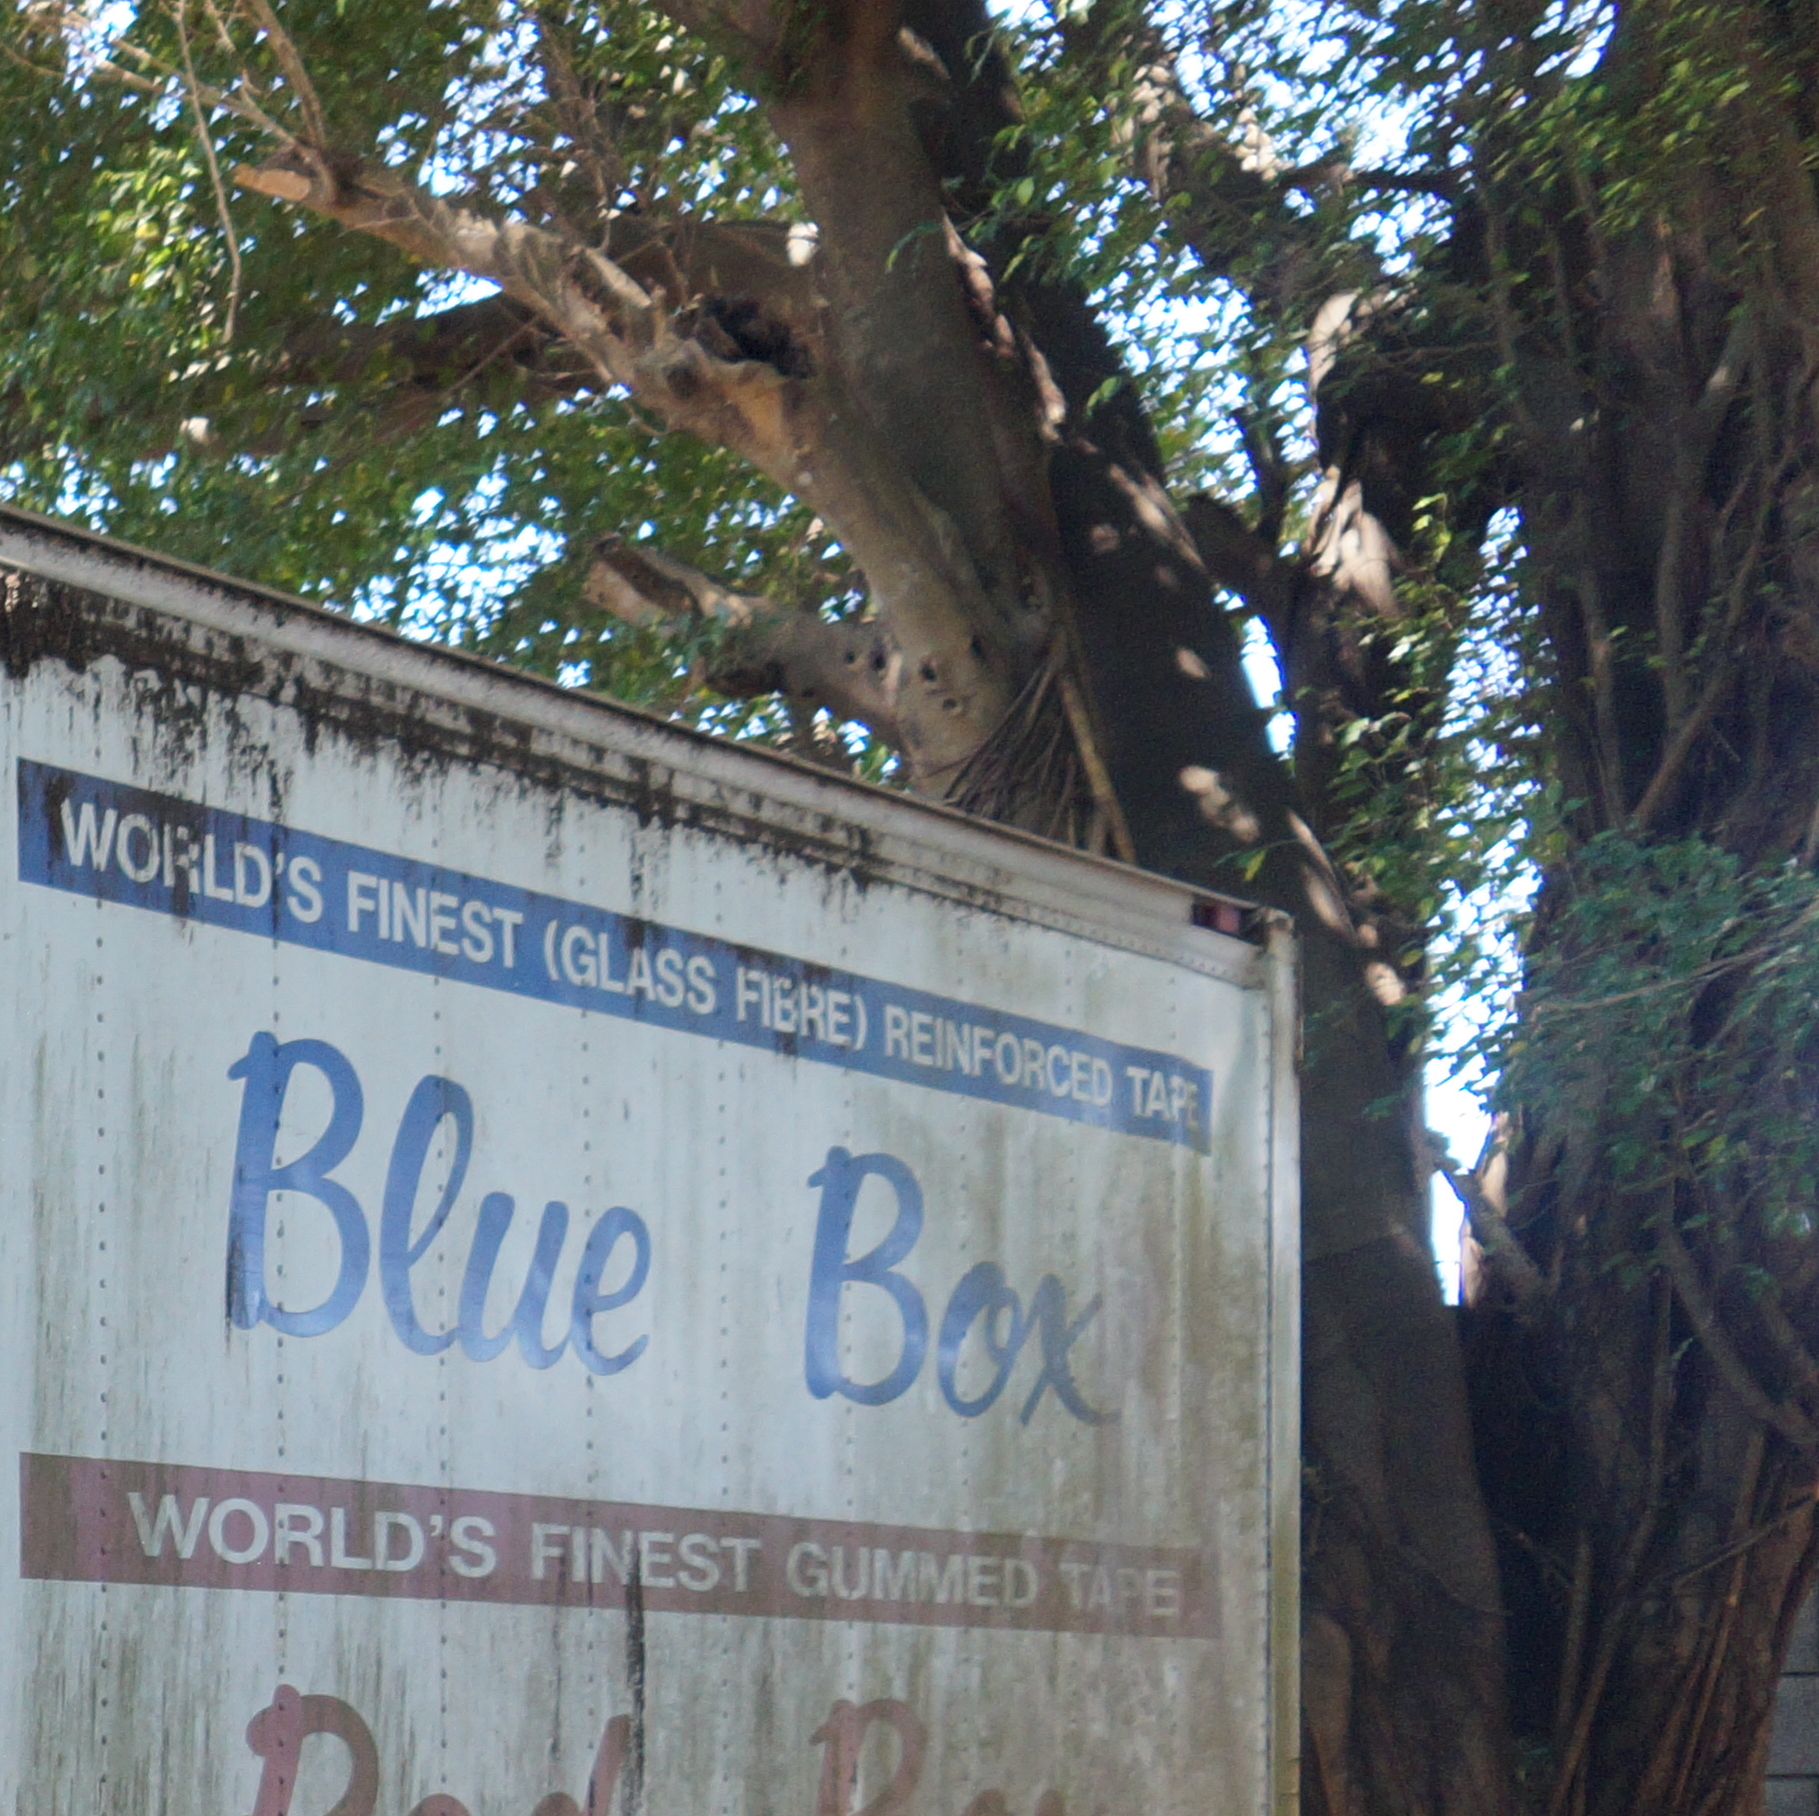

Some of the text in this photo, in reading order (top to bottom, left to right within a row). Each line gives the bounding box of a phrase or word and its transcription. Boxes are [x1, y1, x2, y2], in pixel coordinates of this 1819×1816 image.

[60, 797, 1199, 1130] WORLD'S FINEST (GLASS FIBRE) REINFORCED TAPE
[226, 1030, 1121, 1425] Blue Box
[128, 1492, 1179, 1618] WORLD'S FINEST GUMMED TAPE
